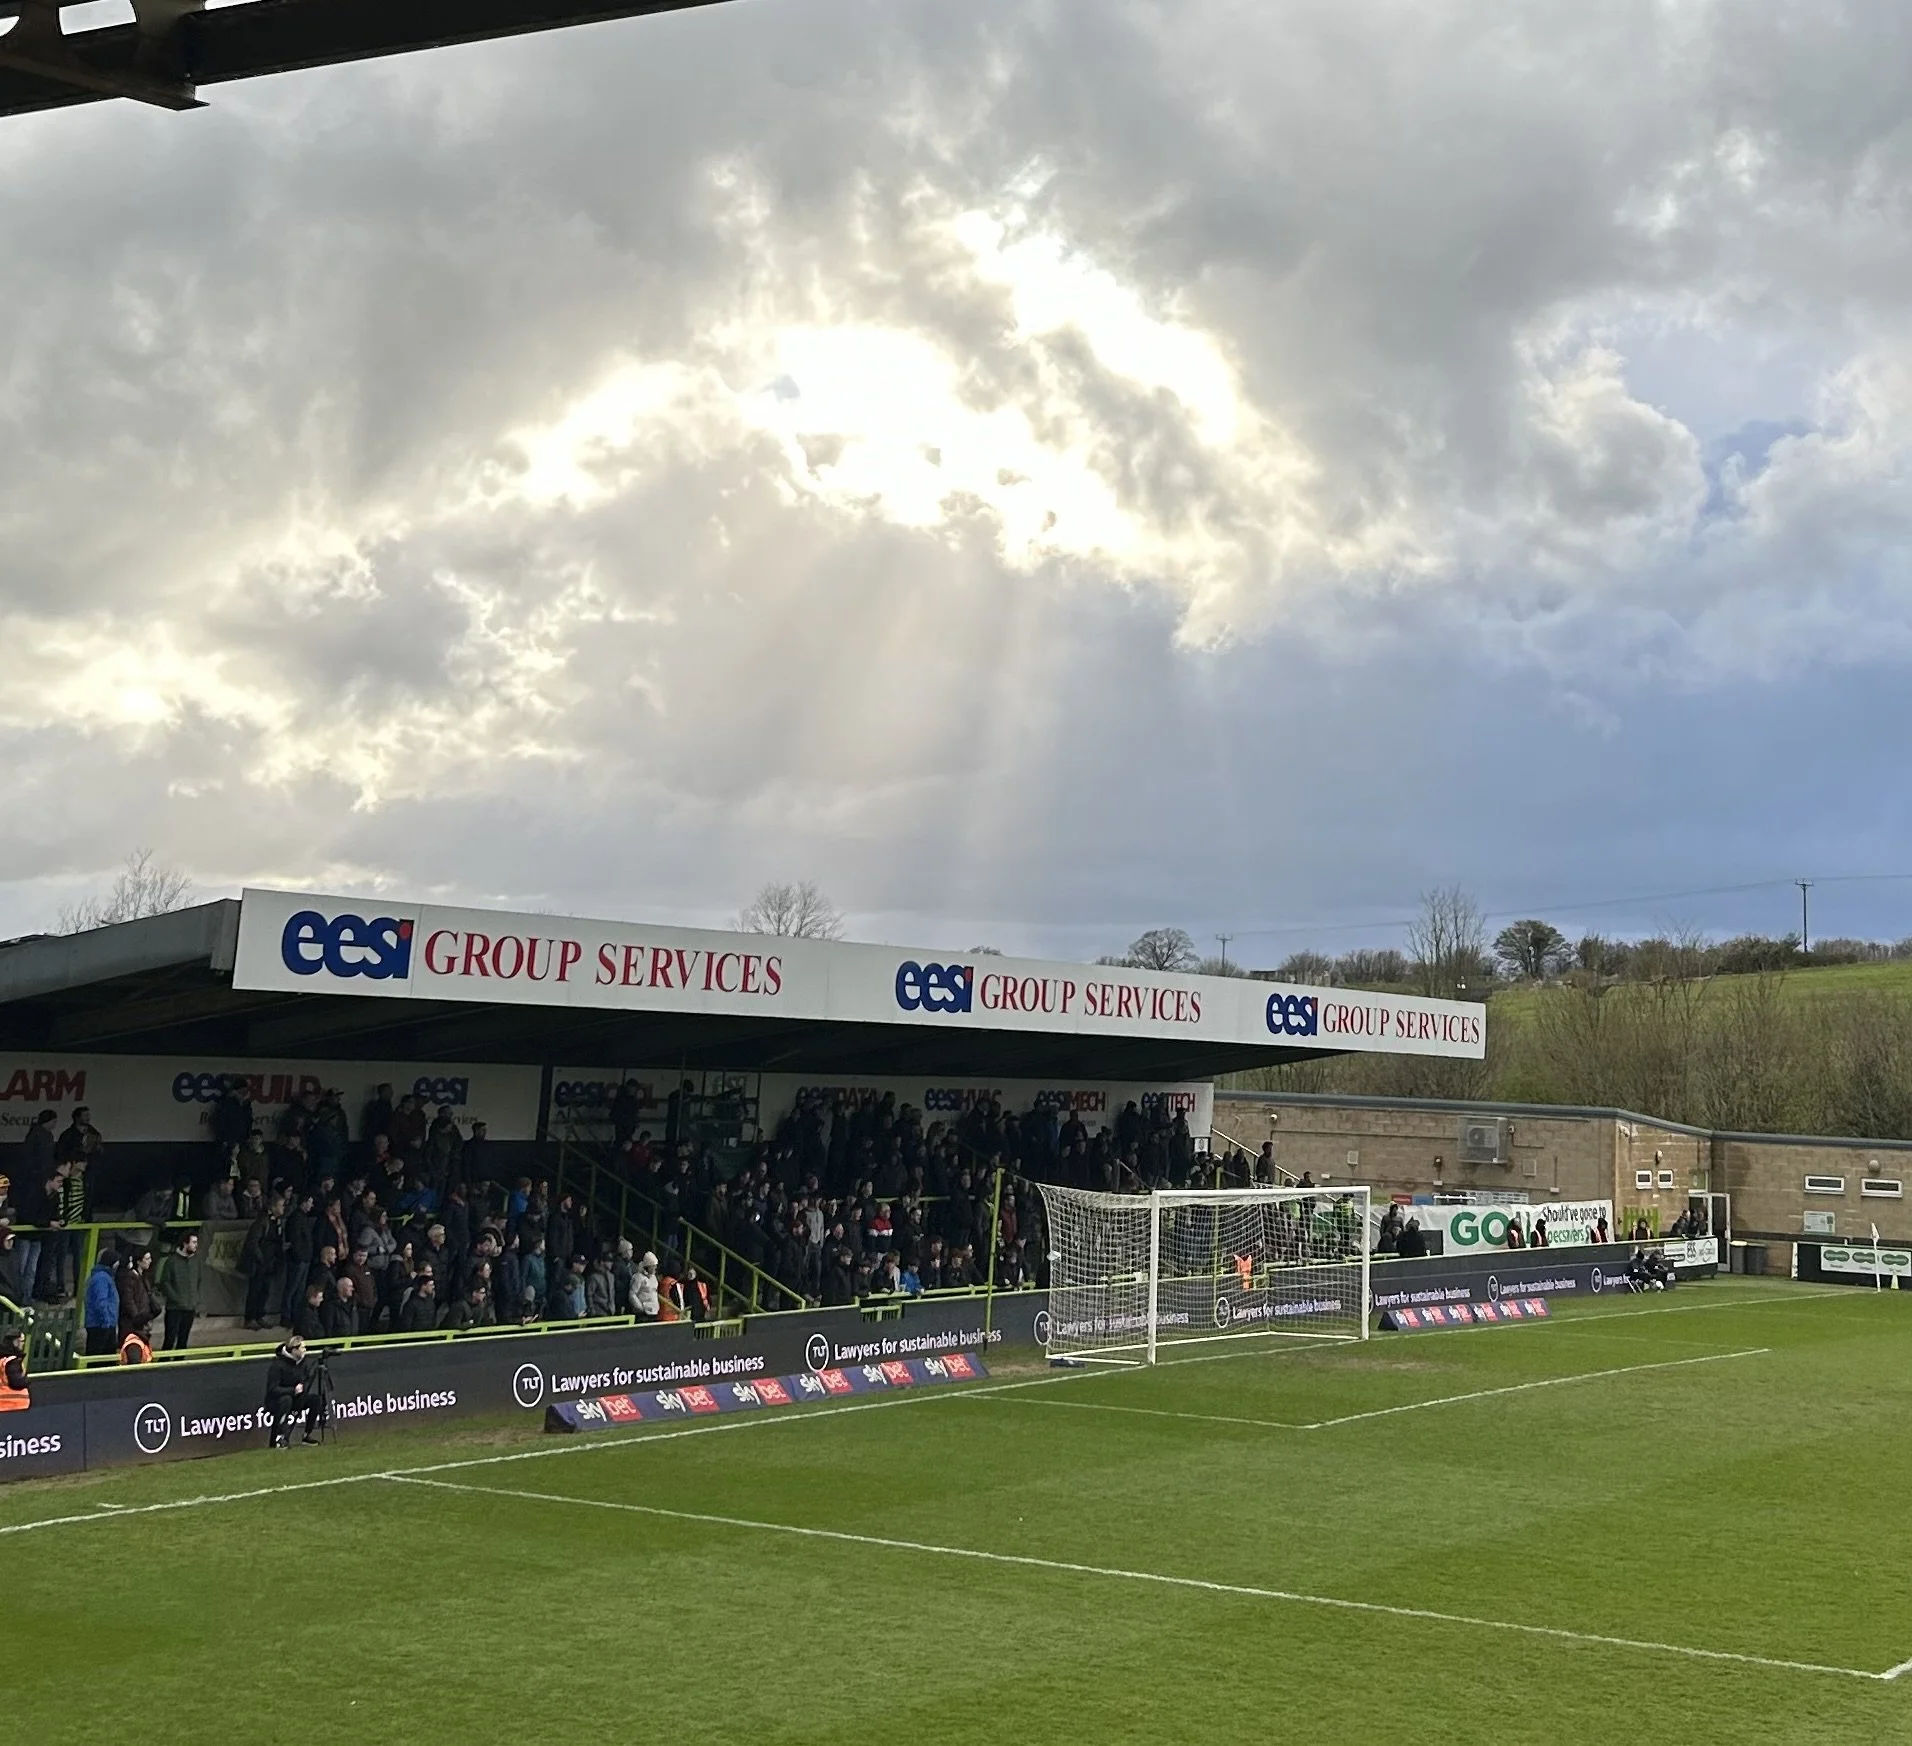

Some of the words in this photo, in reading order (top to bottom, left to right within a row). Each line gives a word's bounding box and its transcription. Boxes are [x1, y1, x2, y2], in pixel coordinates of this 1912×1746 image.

[281, 910, 413, 979] eesi
[425, 930, 581, 982] GROUP
[595, 943, 783, 996] SERVICES
[895, 961, 973, 1013] eesi
[980, 973, 1076, 1016] GROUP
[1084, 981, 1201, 1024] SERVICES
[1266, 993, 1318, 1036] eesi
[1323, 1004, 1391, 1037] GROUP
[1396, 1009, 1481, 1044] SERVICES
[1375, 1293, 1400, 1308] Lawyers
[834, 1340, 880, 1361] Lawyers
[882, 1337, 898, 1354] for
[900, 1331, 957, 1352] sustainable
[551, 1372, 610, 1394] Lawyers
[612, 1366, 634, 1385] for
[636, 1358, 710, 1383] sustainable
[712, 1355, 765, 1375] business
[862, 1364, 888, 1385] sky
[881, 1361, 910, 1380] bet
[924, 1357, 949, 1378] sky
[944, 1353, 970, 1373] bet
[522, 1376, 540, 1391] TLT
[732, 1382, 762, 1405] sky
[757, 1379, 786, 1401] bet
[800, 1373, 826, 1394] sky
[821, 1368, 849, 1389] bet
[576, 1399, 607, 1422] sky
[604, 1395, 637, 1416] bet
[655, 1389, 687, 1412] sky
[681, 1385, 714, 1406] bet
[144, 1417, 167, 1434] TLT
[180, 1412, 252, 1439] Lawyers
[386, 1389, 457, 1413] business
